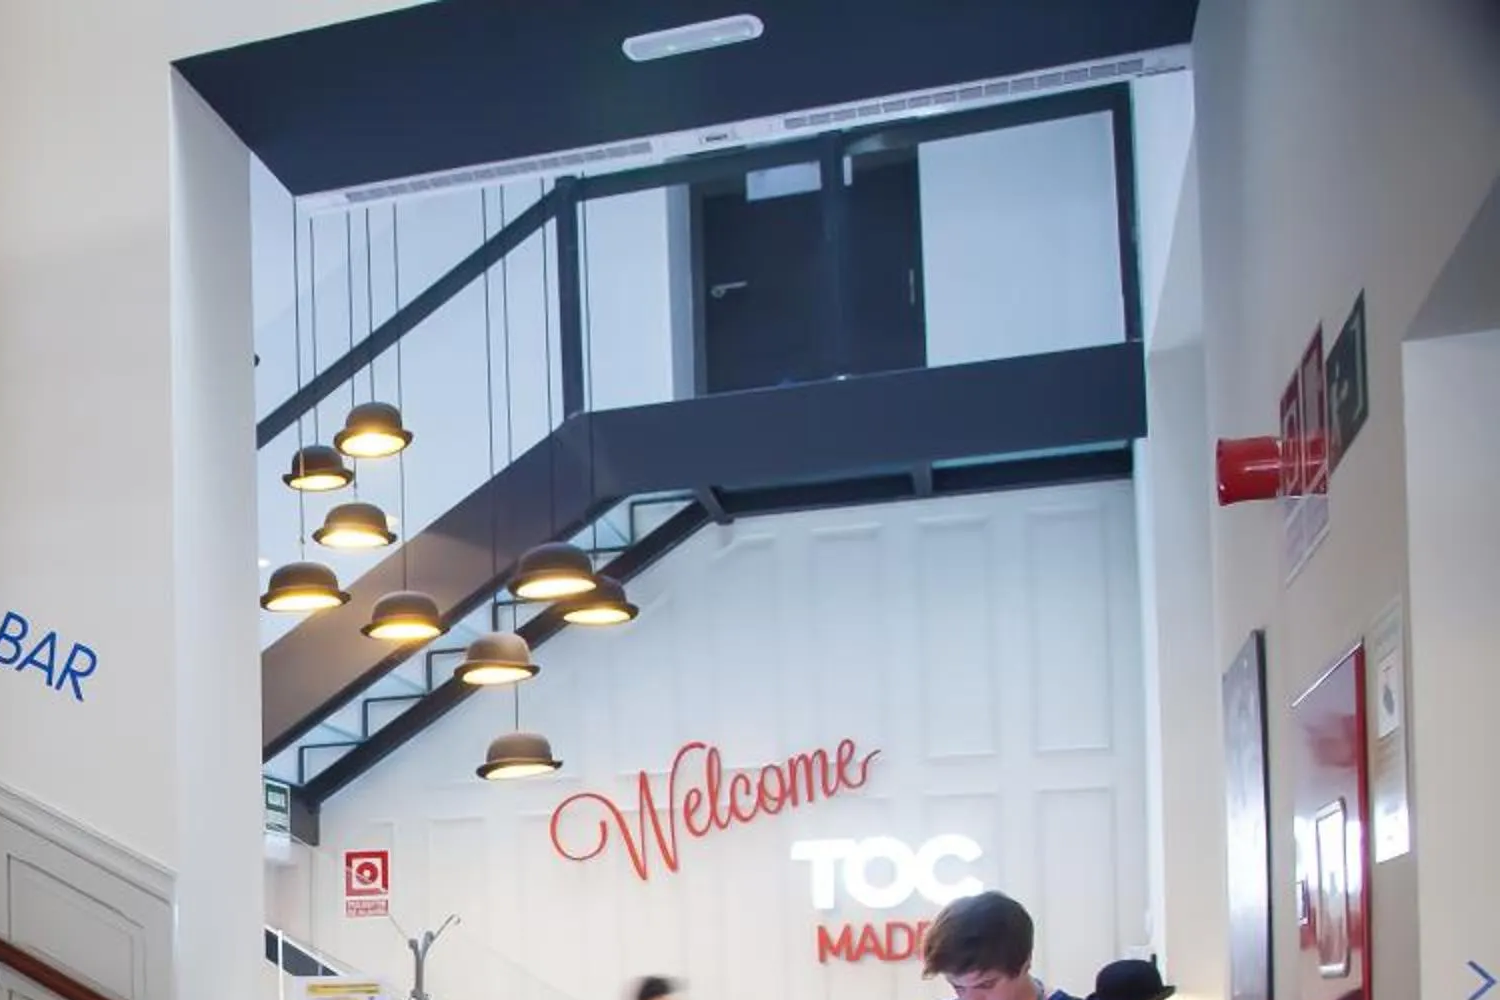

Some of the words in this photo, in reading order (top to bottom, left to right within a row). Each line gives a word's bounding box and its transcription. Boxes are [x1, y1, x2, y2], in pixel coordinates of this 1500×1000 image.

[549, 738, 882, 882] Welcome
[790, 834, 986, 910] TOC
[816, 920, 934, 965] MAD
